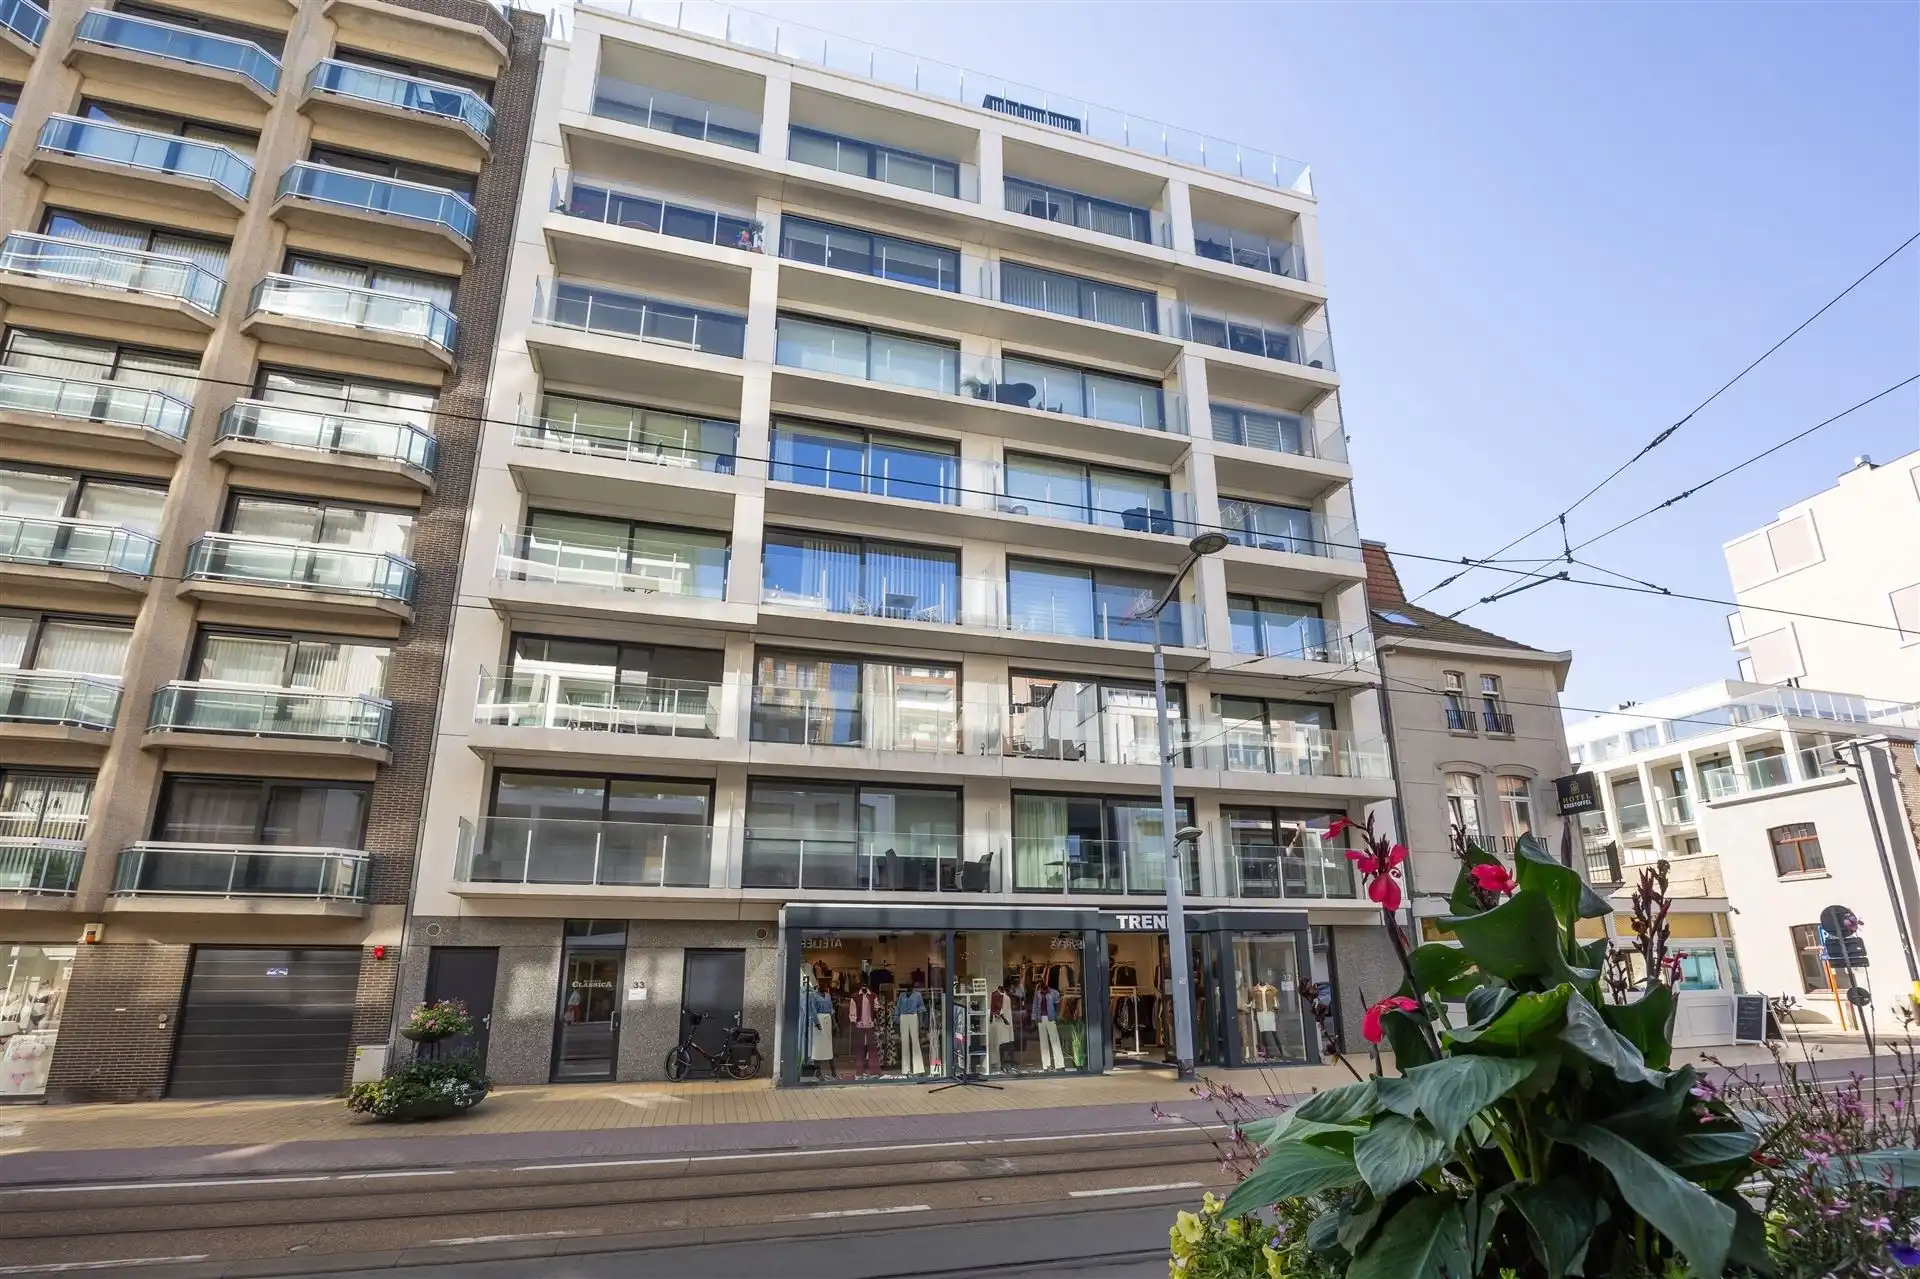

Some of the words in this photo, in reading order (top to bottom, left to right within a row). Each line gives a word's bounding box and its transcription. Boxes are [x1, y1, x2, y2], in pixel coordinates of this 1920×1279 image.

[1563, 793, 1592, 803] HOTEL
[1115, 915, 1169, 929] TREN
[633, 981, 645, 989] 33
